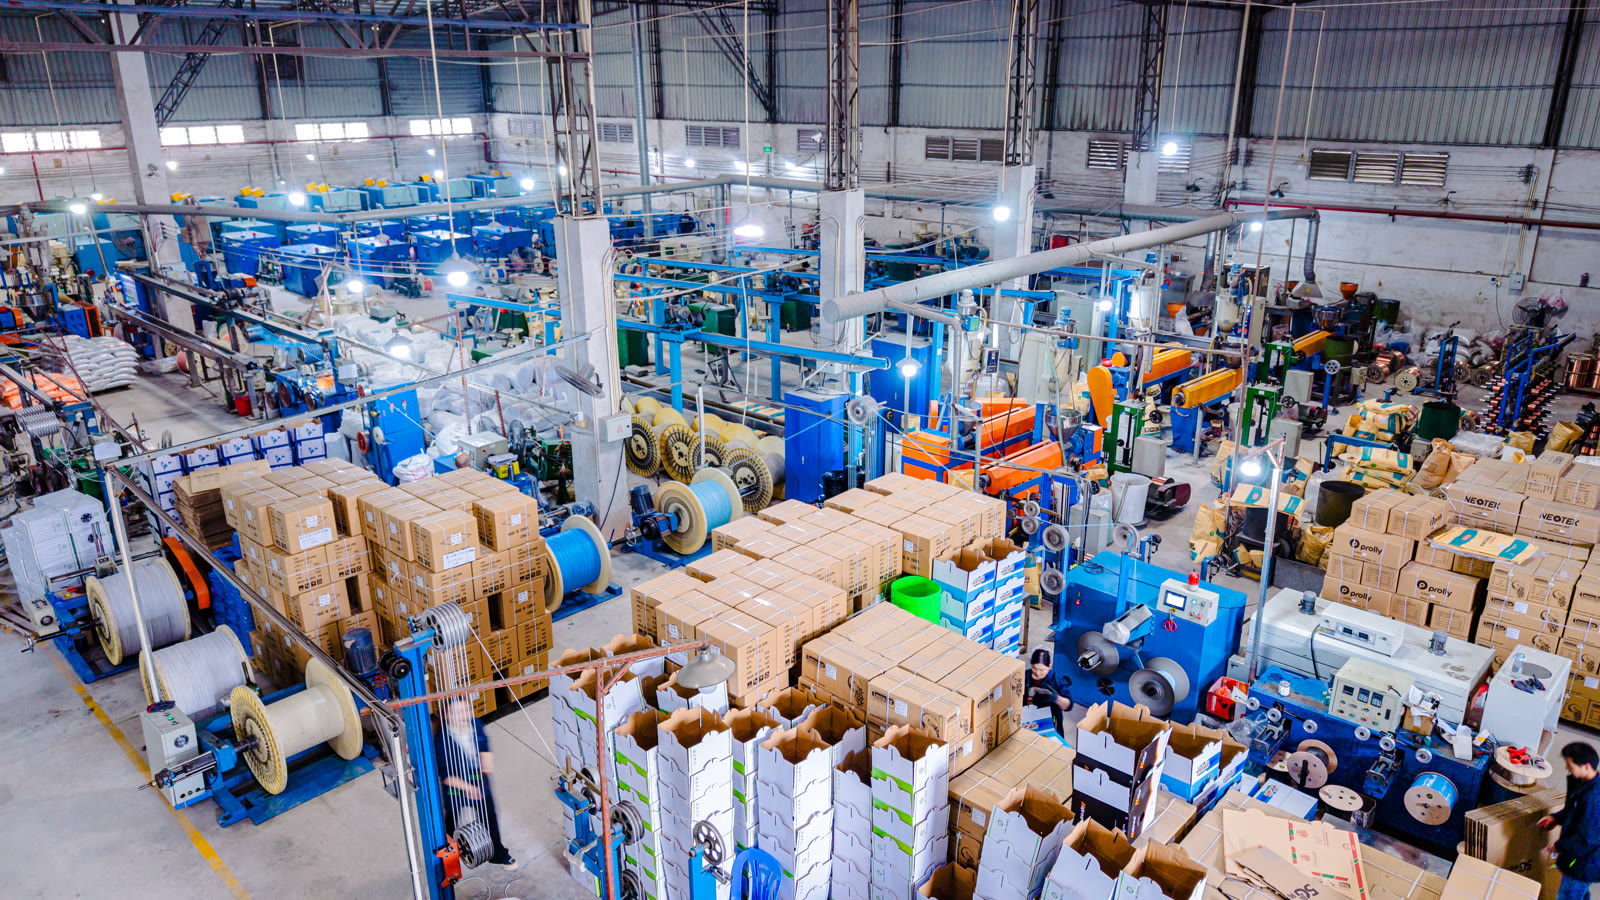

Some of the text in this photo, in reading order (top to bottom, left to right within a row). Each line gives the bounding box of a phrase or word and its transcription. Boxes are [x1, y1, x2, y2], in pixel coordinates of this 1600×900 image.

[1465, 495, 1501, 510] NEOTEK
[1539, 512, 1580, 527] NEOTEK
[1360, 544, 1383, 555] prolly
[1350, 590, 1372, 602] prolly
[1428, 585, 1453, 597] prolly
[1293, 883, 1320, 899] 5G
